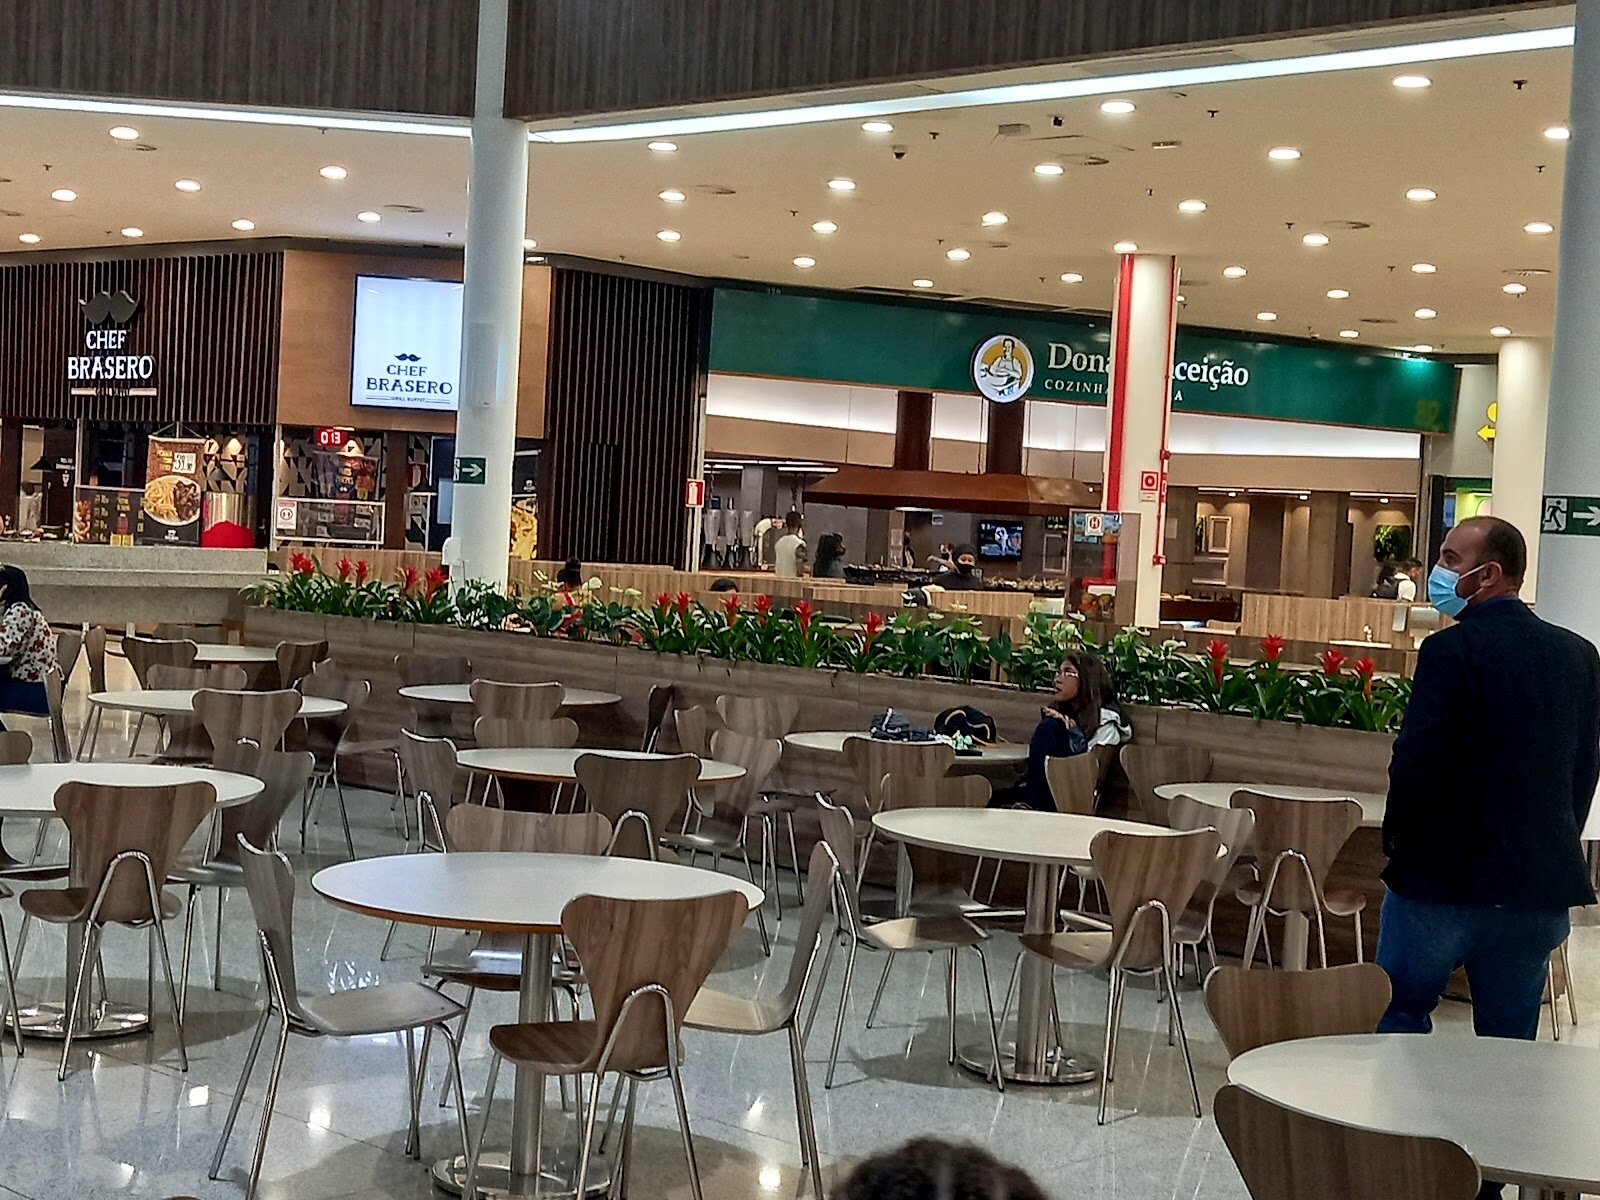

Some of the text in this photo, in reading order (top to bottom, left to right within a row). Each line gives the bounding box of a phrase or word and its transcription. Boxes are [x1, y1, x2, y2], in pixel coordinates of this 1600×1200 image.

[86, 330, 127, 349] CHEF
[67, 355, 153, 380] BRASERO
[386, 364, 427, 376] CHEF
[1172, 356, 1249, 390] ceição
[366, 377, 452, 394] BRASERO
[1044, 379, 1109, 395] COZINH
[320, 431, 341, 444] 013
